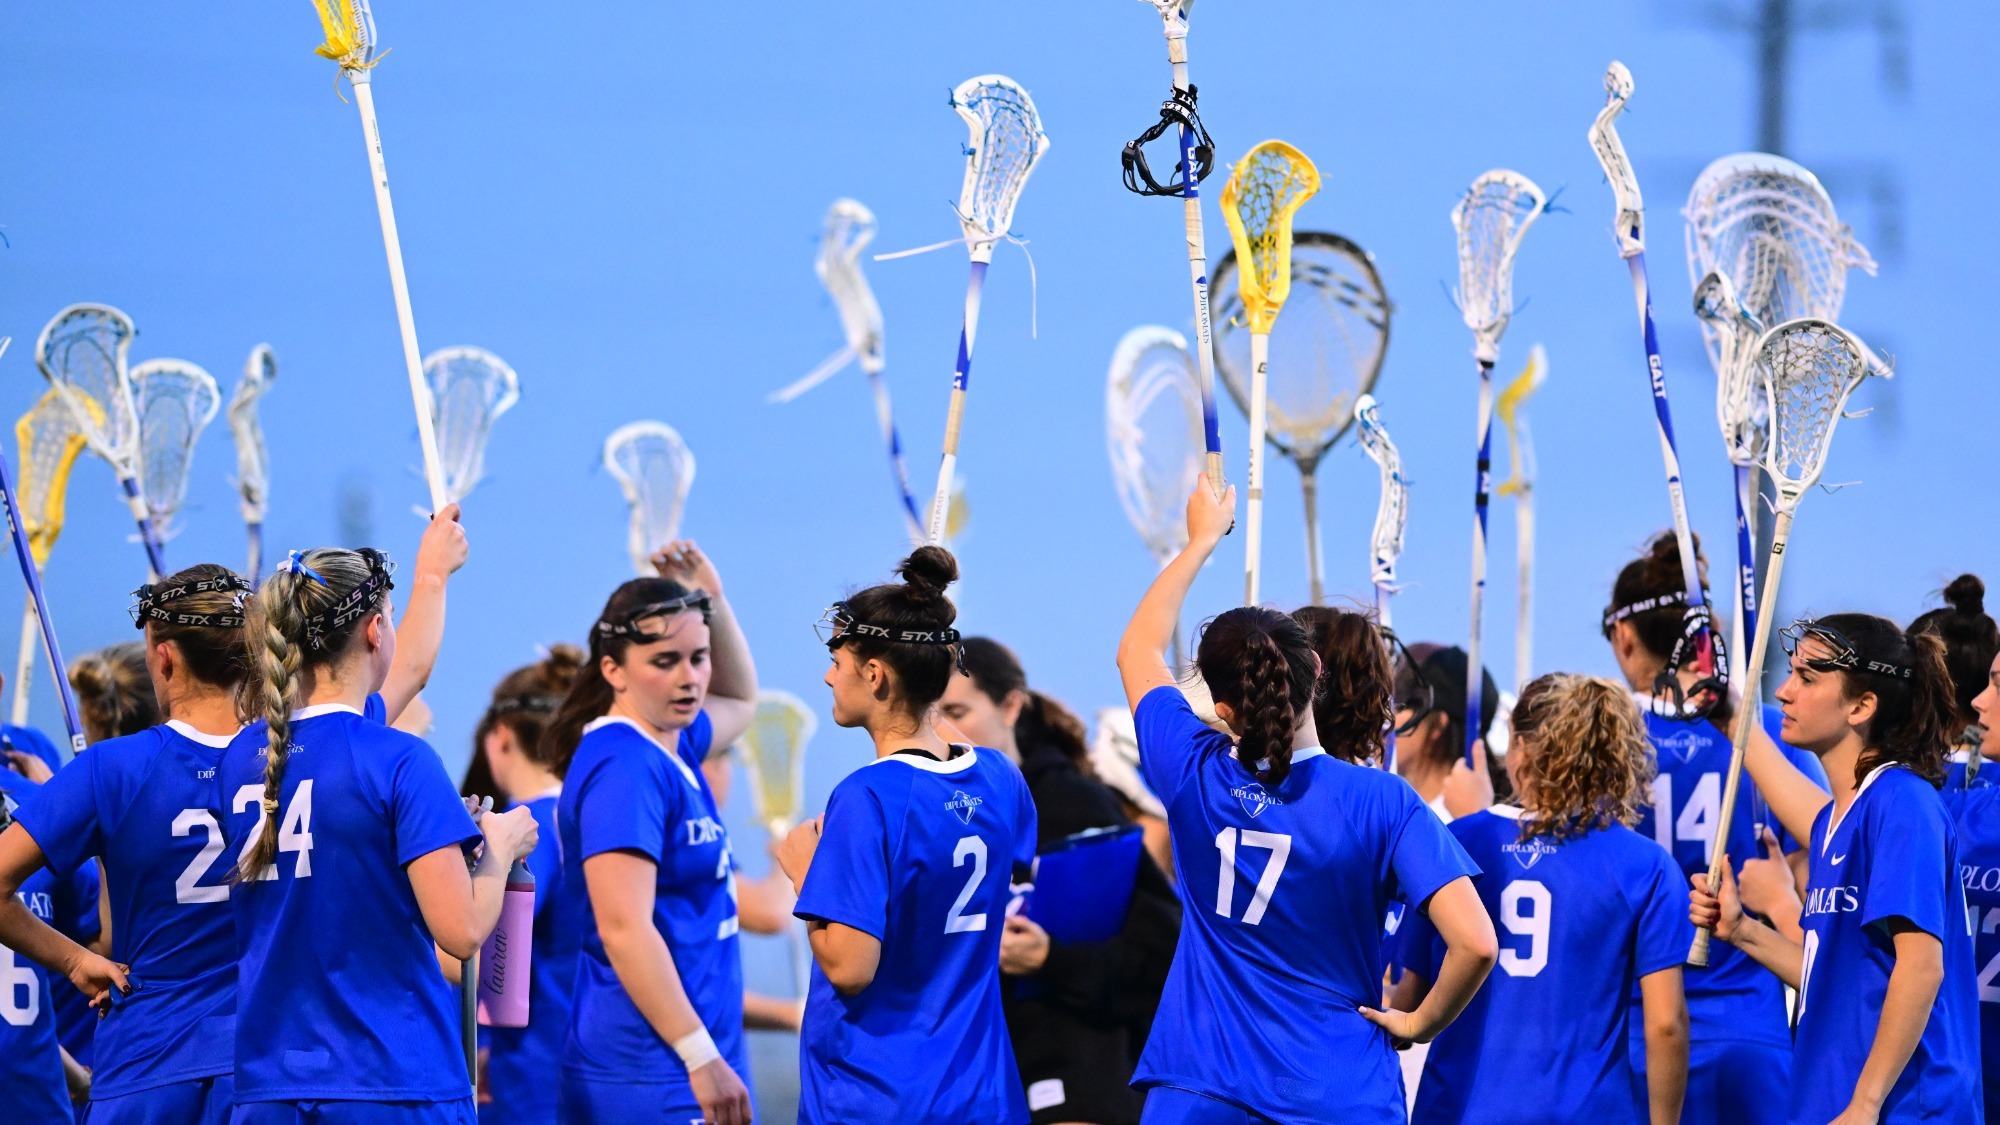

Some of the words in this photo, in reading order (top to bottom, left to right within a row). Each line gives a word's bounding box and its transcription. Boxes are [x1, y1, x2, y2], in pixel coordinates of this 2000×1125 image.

[1199, 290, 1210, 344] DIPLOMATS
[1648, 354, 1668, 399] GAIT
[161, 585, 187, 602] STX
[333, 588, 363, 616] STX
[1742, 565, 1756, 611] GAIT
[150, 607, 171, 621] STX
[178, 614, 210, 625] STX
[220, 616, 244, 626] ST
[333, 603, 365, 629] STX
[857, 623, 890, 638] STX
[900, 631, 934, 642] STX
[1867, 660, 1898, 676] STX
[944, 796, 983, 811] DIPLOMATS
[1230, 787, 1283, 806] DIPLOMATS
[1652, 771, 1721, 867] 14
[232, 779, 313, 882] 24
[172, 808, 229, 904] 2
[1215, 826, 1292, 926] 17
[943, 834, 988, 935] 2
[1499, 879, 1552, 977] 9
[484, 928, 508, 995] lauren
